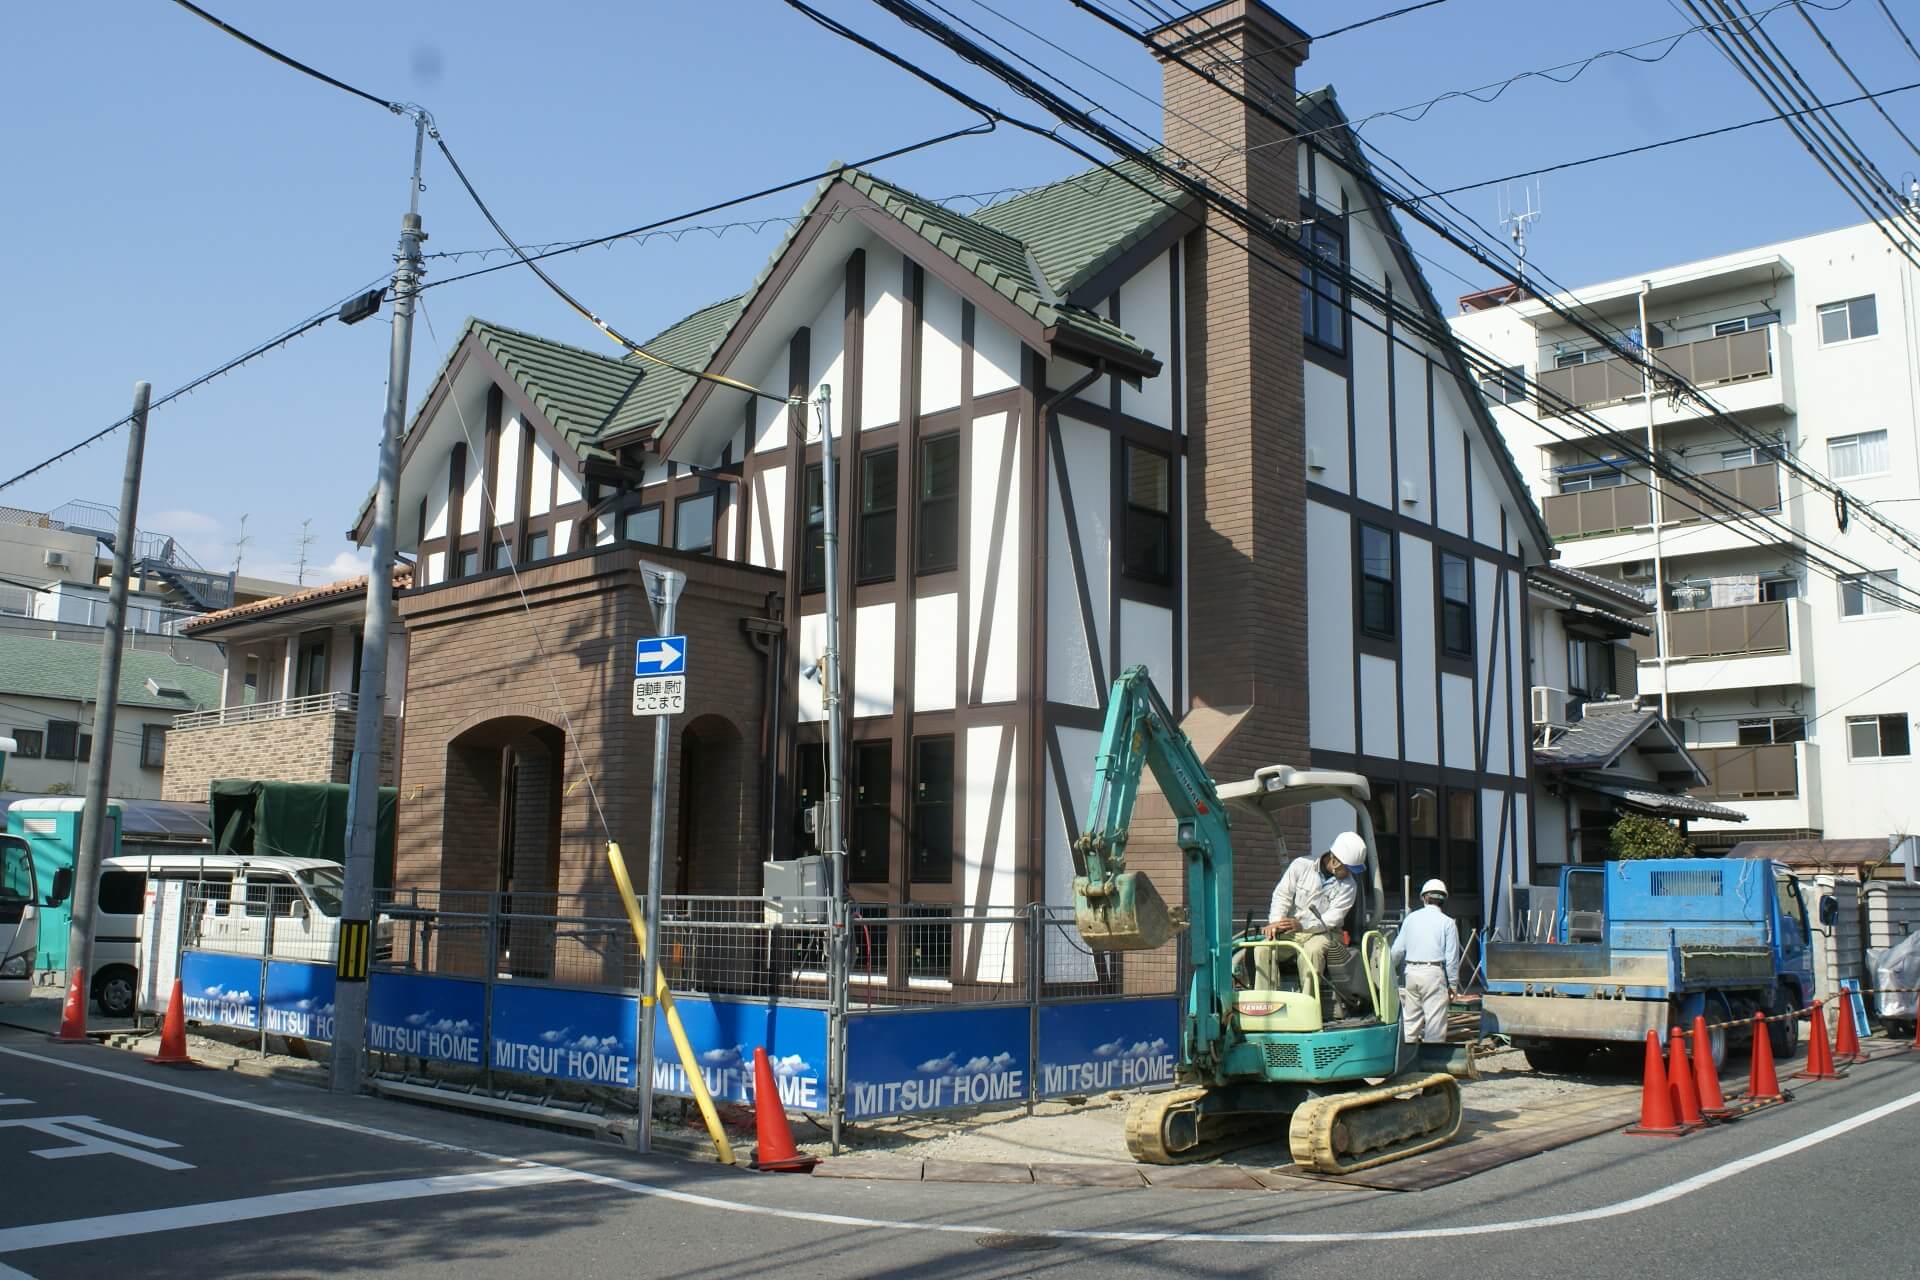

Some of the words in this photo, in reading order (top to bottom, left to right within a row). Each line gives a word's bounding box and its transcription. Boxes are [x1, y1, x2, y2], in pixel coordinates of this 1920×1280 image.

[636, 696, 682, 710] ここまで
[220, 1001, 256, 1026] HOME
[267, 1007, 311, 1035] MITSUI
[316, 1015, 335, 1039] HO
[371, 1023, 421, 1053] MITSUI
[429, 1032, 479, 1062] HOME
[496, 1040, 558, 1074] MITSUI
[568, 1050, 629, 1084] HOME
[652, 1062, 728, 1097] MITUI
[741, 1072, 817, 1108] HME
[854, 1078, 941, 1116] MITSUI
[953, 1070, 1023, 1105] HOME
[1044, 1061, 1112, 1093] MITSUI
[1121, 1054, 1174, 1085] HOME
